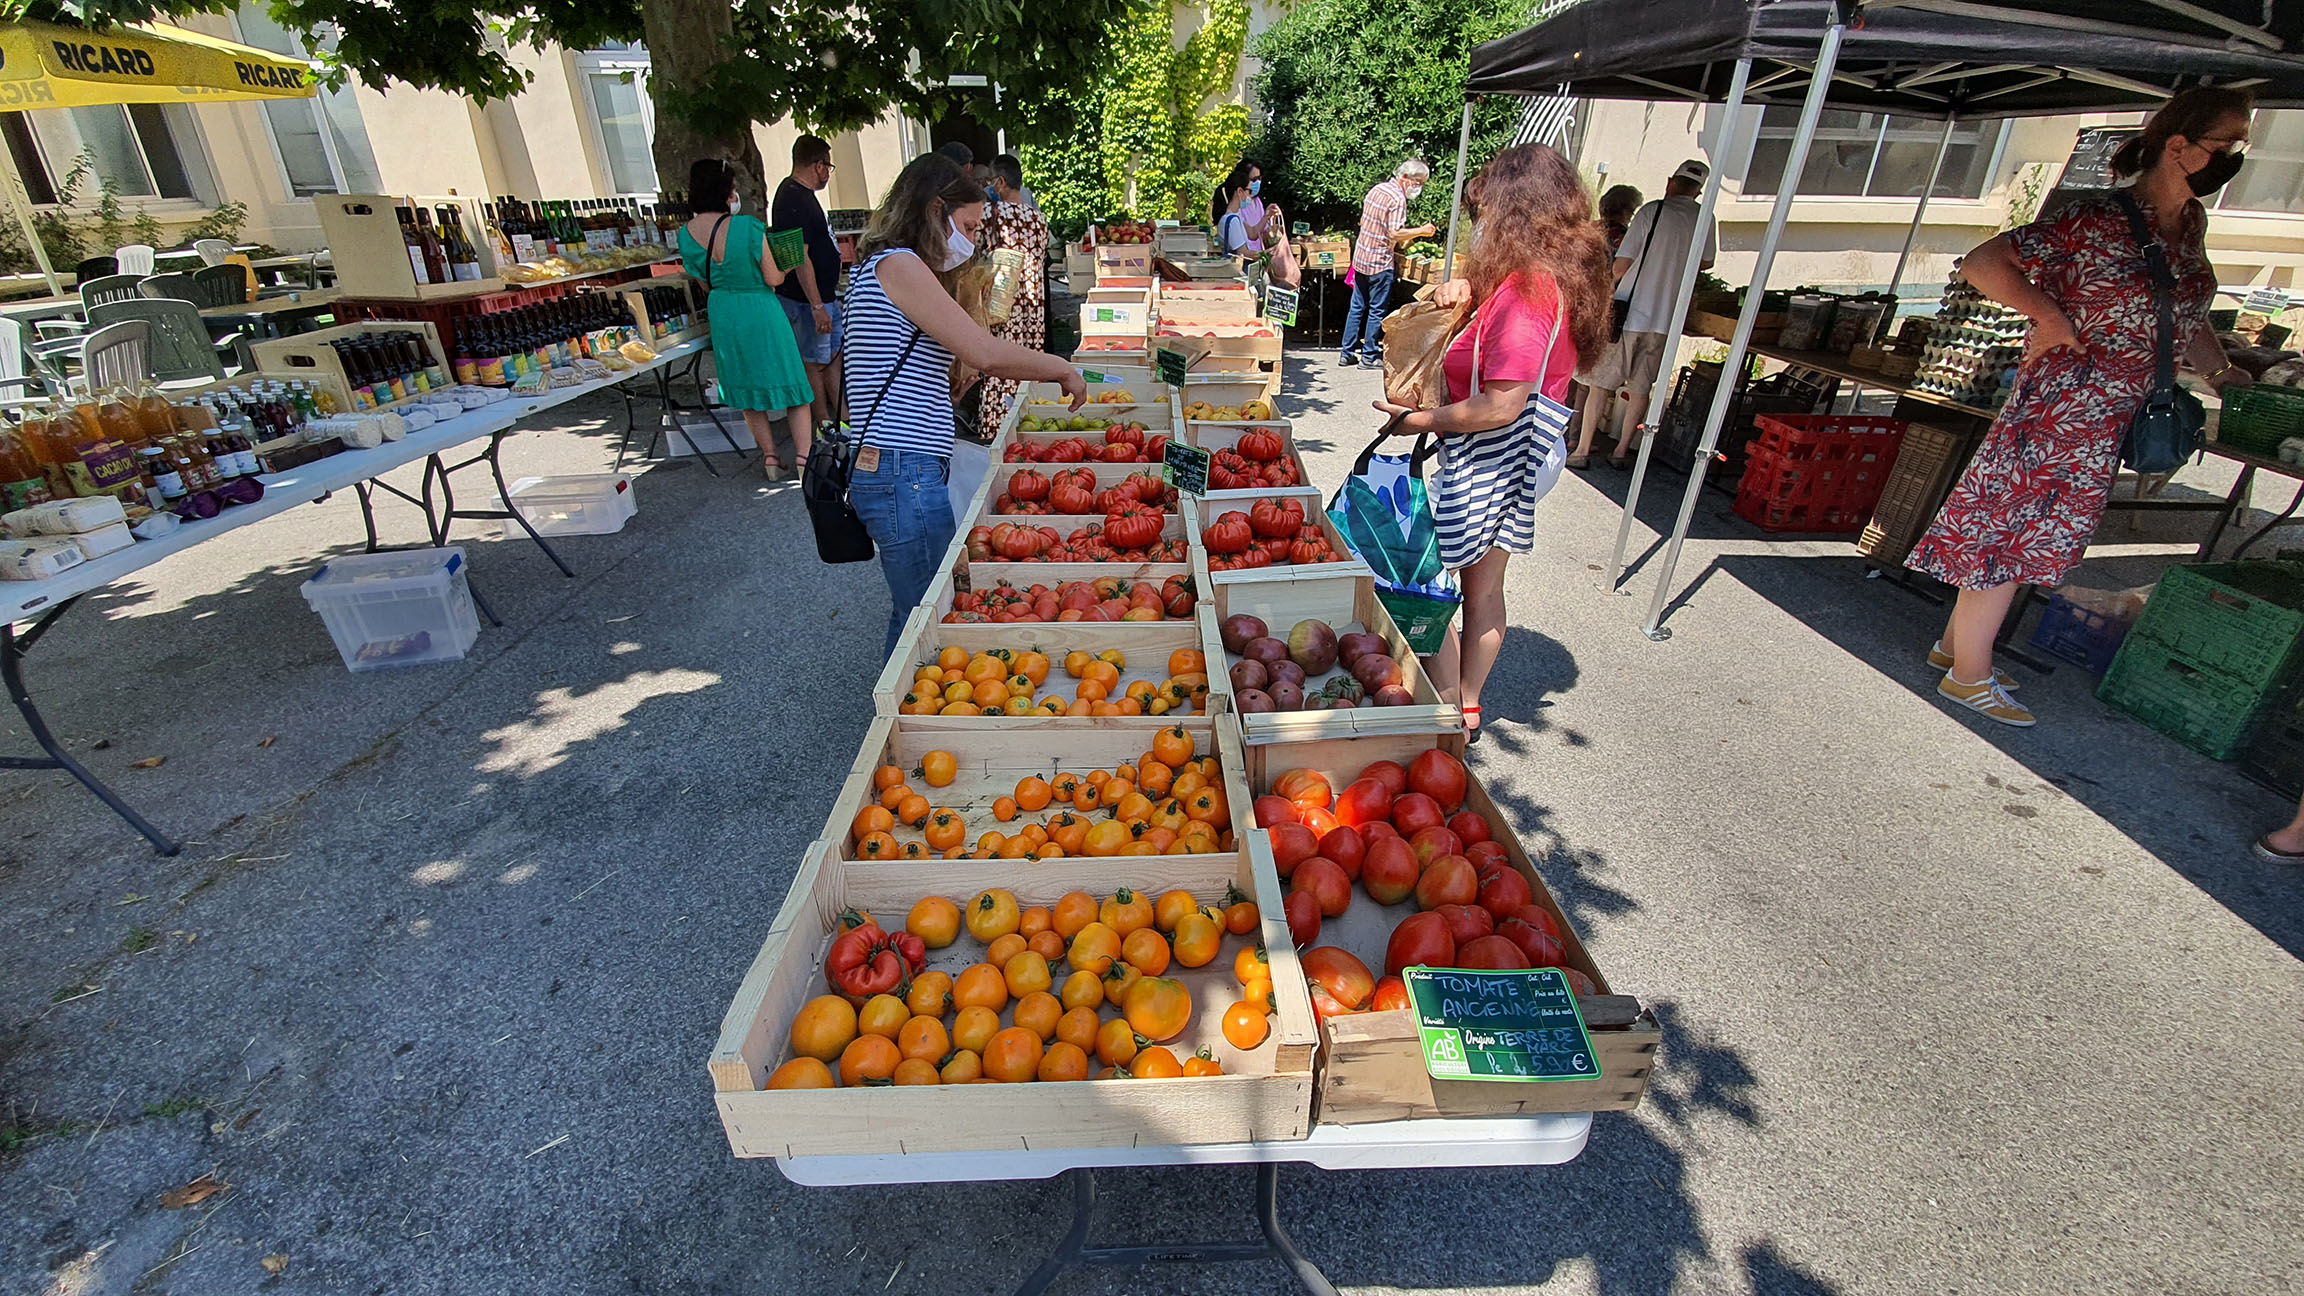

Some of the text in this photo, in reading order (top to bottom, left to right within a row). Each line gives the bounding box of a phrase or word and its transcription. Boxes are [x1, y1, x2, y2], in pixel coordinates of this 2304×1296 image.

[52, 40, 155, 76] RICARD
[233, 61, 304, 89] RICARD
[95, 461, 123, 478] CACAO
[1434, 975, 1519, 998] TOMATE
[1442, 998, 1541, 1018] ANCIENNE
[1494, 1029, 1548, 1047] TERRE
[1555, 1028, 1577, 1043] DE
[1526, 1042, 1573, 1054] MARS
[1432, 1038, 1460, 1060] AB
